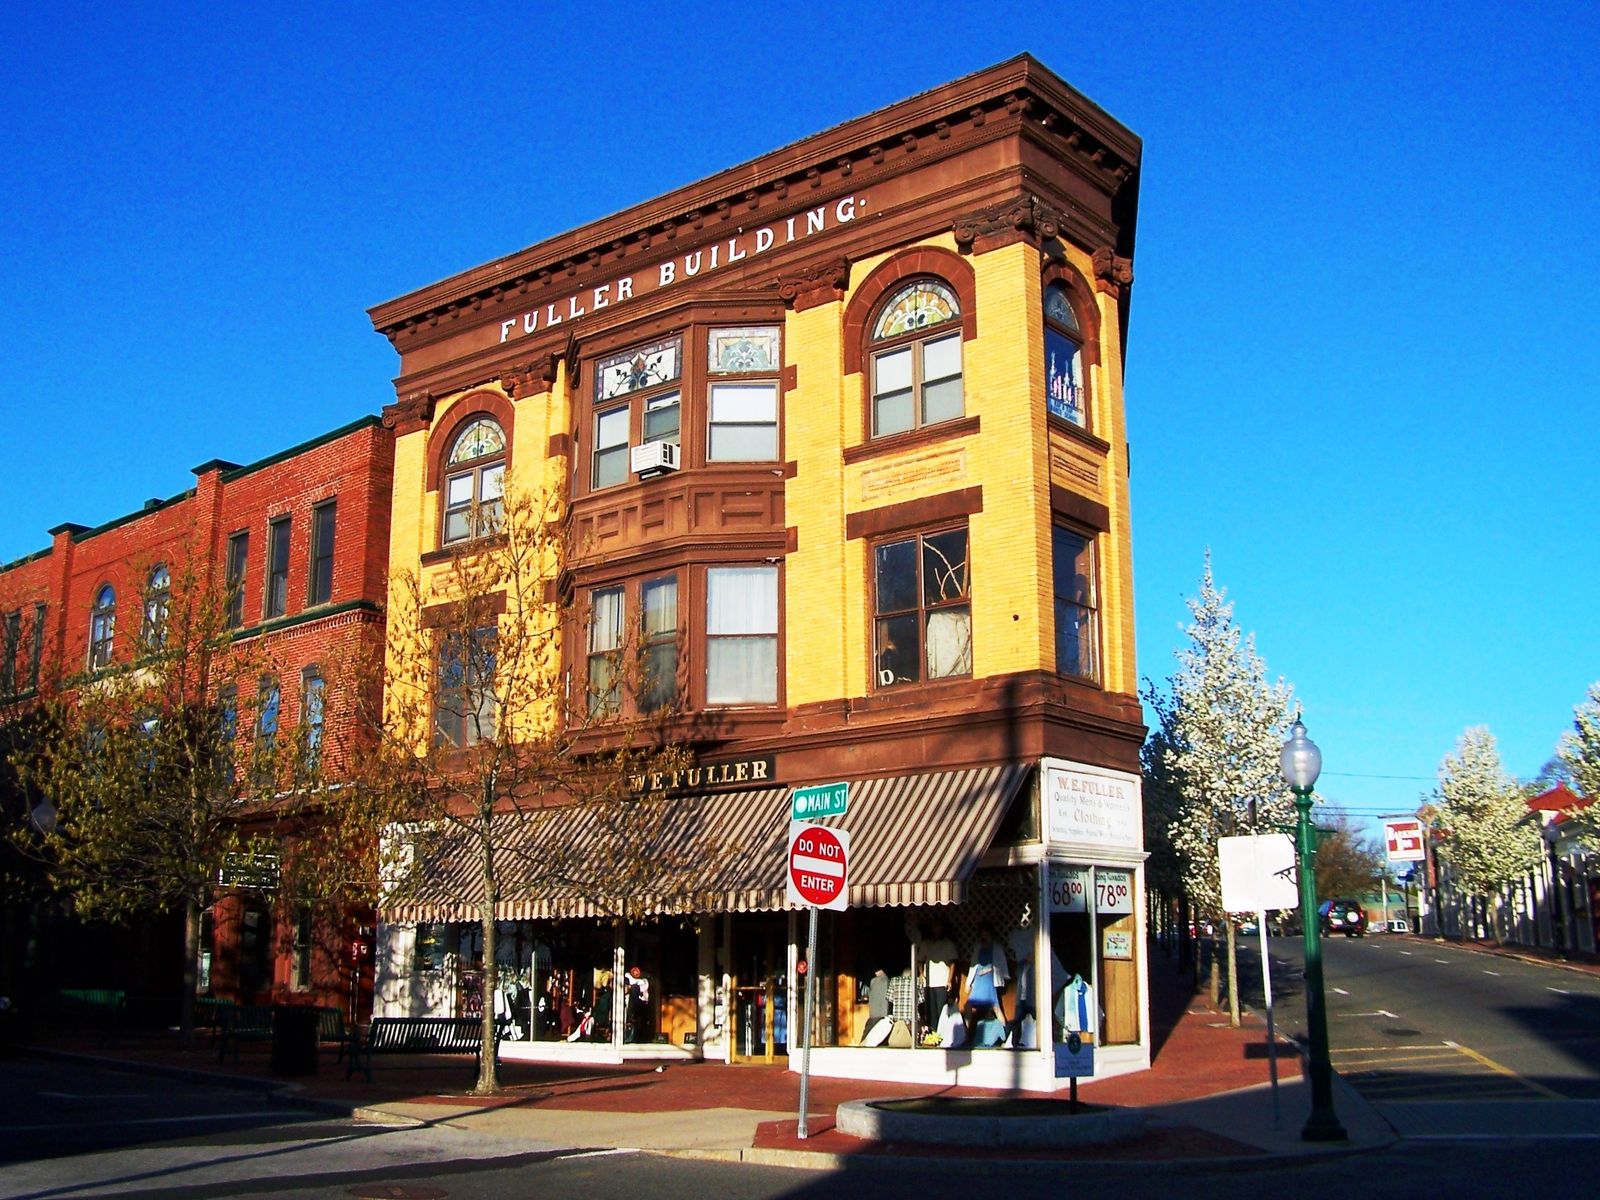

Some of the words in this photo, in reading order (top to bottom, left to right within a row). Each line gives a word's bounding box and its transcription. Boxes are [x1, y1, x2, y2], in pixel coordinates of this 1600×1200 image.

[500, 276, 634, 343] FULLER
[671, 760, 768, 788] FULLER
[807, 791, 831, 812] MAIN
[834, 789, 846, 809] ST
[799, 838, 813, 853] DO
[819, 842, 840, 859] NOT
[801, 874, 835, 893] ENTER
